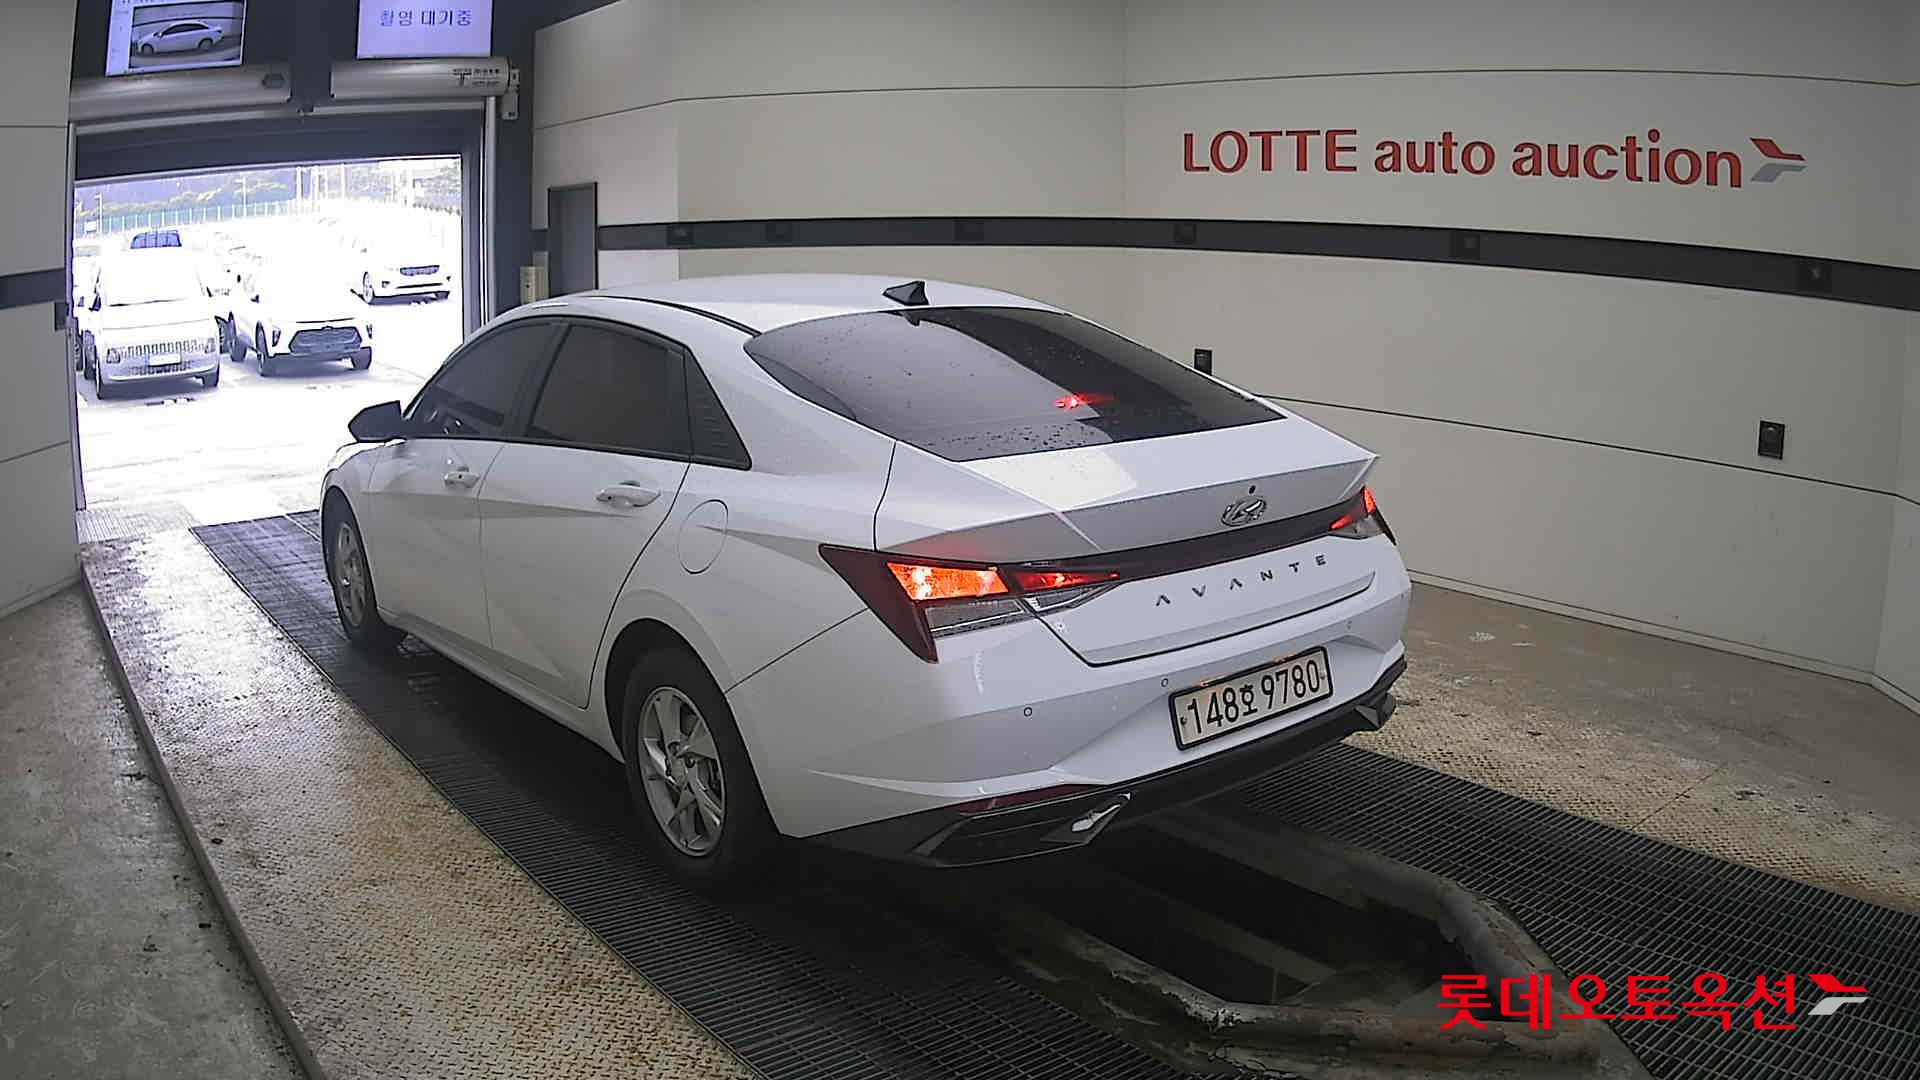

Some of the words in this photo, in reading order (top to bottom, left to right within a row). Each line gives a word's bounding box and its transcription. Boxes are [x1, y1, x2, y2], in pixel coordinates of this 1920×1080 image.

[421, 9, 472, 26] 대기중
[1184, 130, 1357, 172] LOTTE
[1375, 132, 1496, 175] auto
[1512, 129, 1742, 188] auction
[1155, 554, 1327, 606] AVANTE
